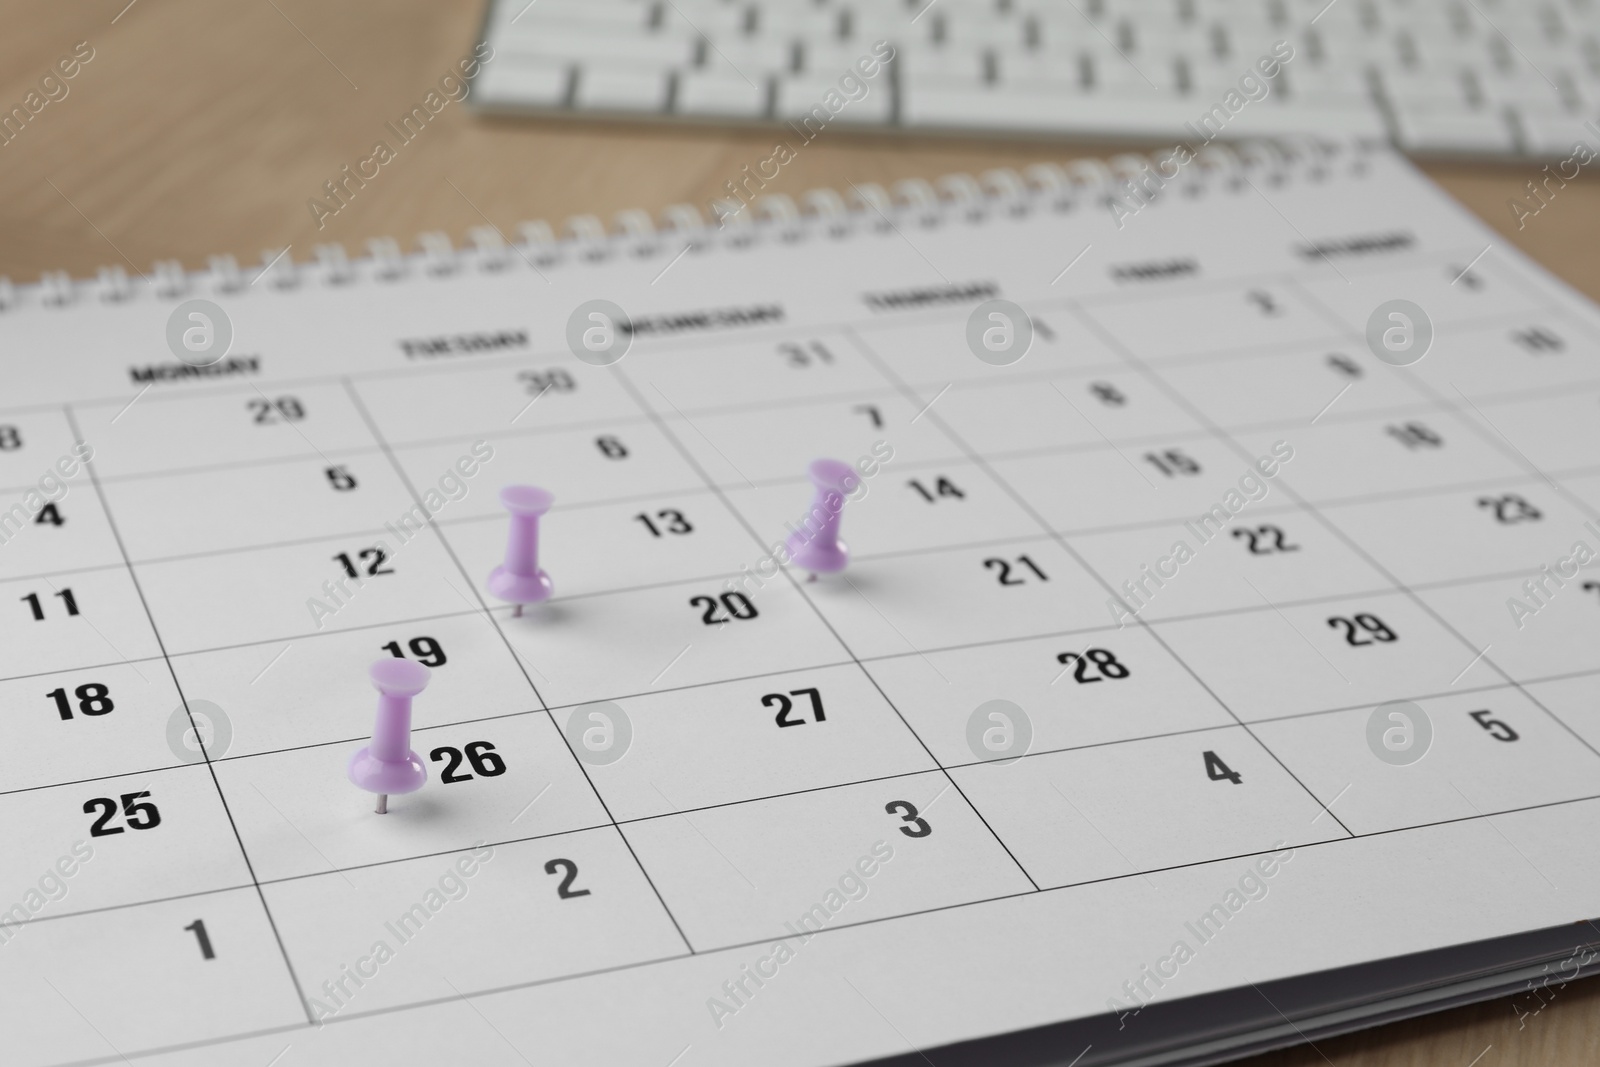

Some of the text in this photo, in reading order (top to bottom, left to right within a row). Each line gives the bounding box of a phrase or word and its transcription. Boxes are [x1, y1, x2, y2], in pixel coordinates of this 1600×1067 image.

[401, 331, 529, 357] TUESDAY
[778, 341, 834, 368] 31
[129, 357, 260, 384] MONDAY
[518, 369, 577, 396] 30
[247, 397, 307, 425] 29
[849, 405, 884, 430] 7
[0, 426, 23, 451] 8
[595, 436, 629, 460] 6
[324, 467, 358, 491] 5
[1144, 450, 1202, 477] 15
[908, 476, 965, 503] 14
[34, 501, 66, 528] 4
[636, 509, 694, 538] 13
[1477, 494, 1543, 525] 23
[1231, 525, 1297, 556] 22
[333, 547, 395, 580] 12
[982, 554, 1049, 587] 21
[21, 587, 80, 622] 11
[689, 590, 760, 626] 20
[1326, 613, 1399, 648] 29
[1056, 648, 1131, 685] 28
[45, 682, 115, 721] 18
[760, 687, 827, 729] 27
[1468, 709, 1520, 743] 5
[429, 740, 507, 785] 26
[1202, 750, 1243, 785] 4
[82, 790, 162, 838] 25
[884, 799, 933, 839] 3
[543, 857, 592, 900] 2
[183, 918, 216, 961] 1
